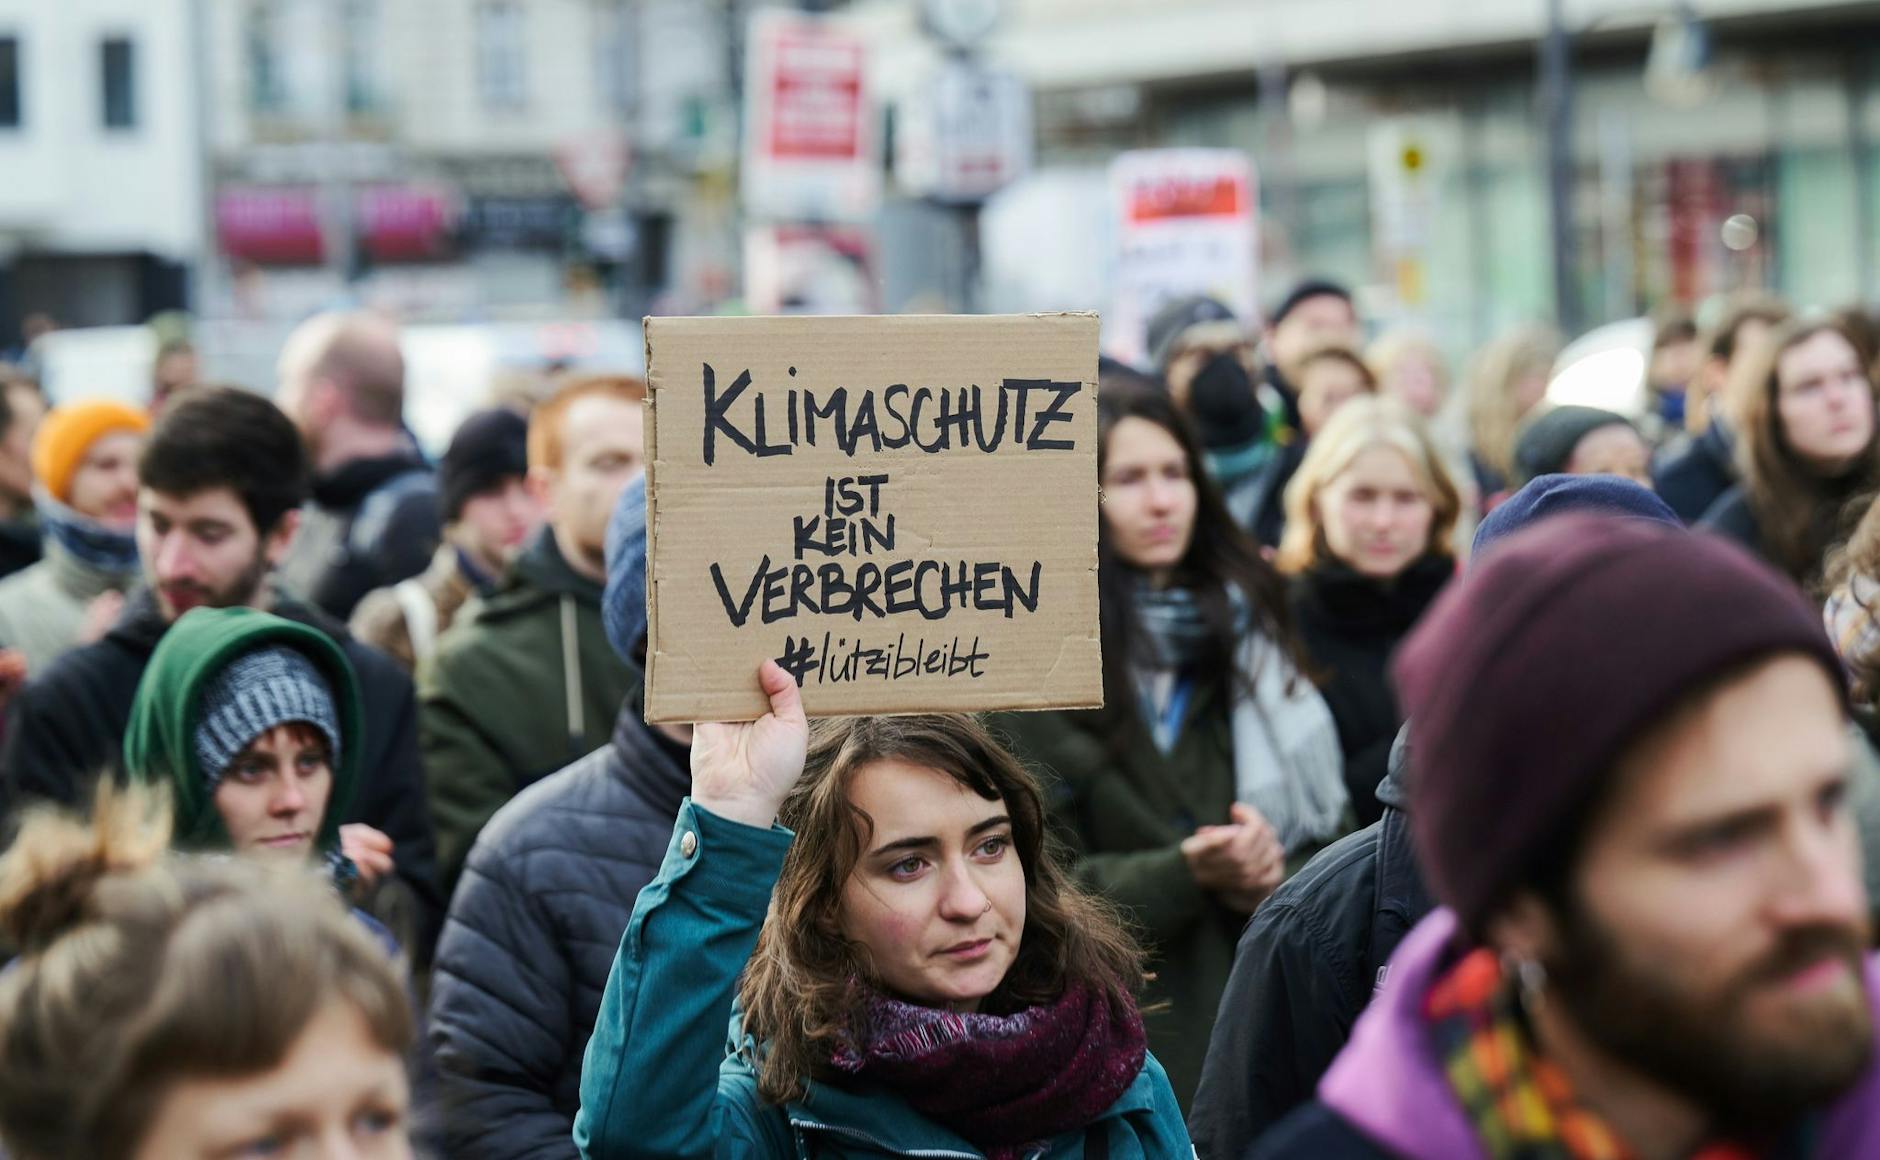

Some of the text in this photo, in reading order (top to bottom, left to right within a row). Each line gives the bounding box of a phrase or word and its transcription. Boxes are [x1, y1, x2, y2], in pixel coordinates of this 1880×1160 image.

[824, 474, 889, 518] IST
[794, 514, 895, 560] KEIN
[709, 555, 1042, 627] VERBRECHEN
[775, 632, 990, 688] #lützibleibt
